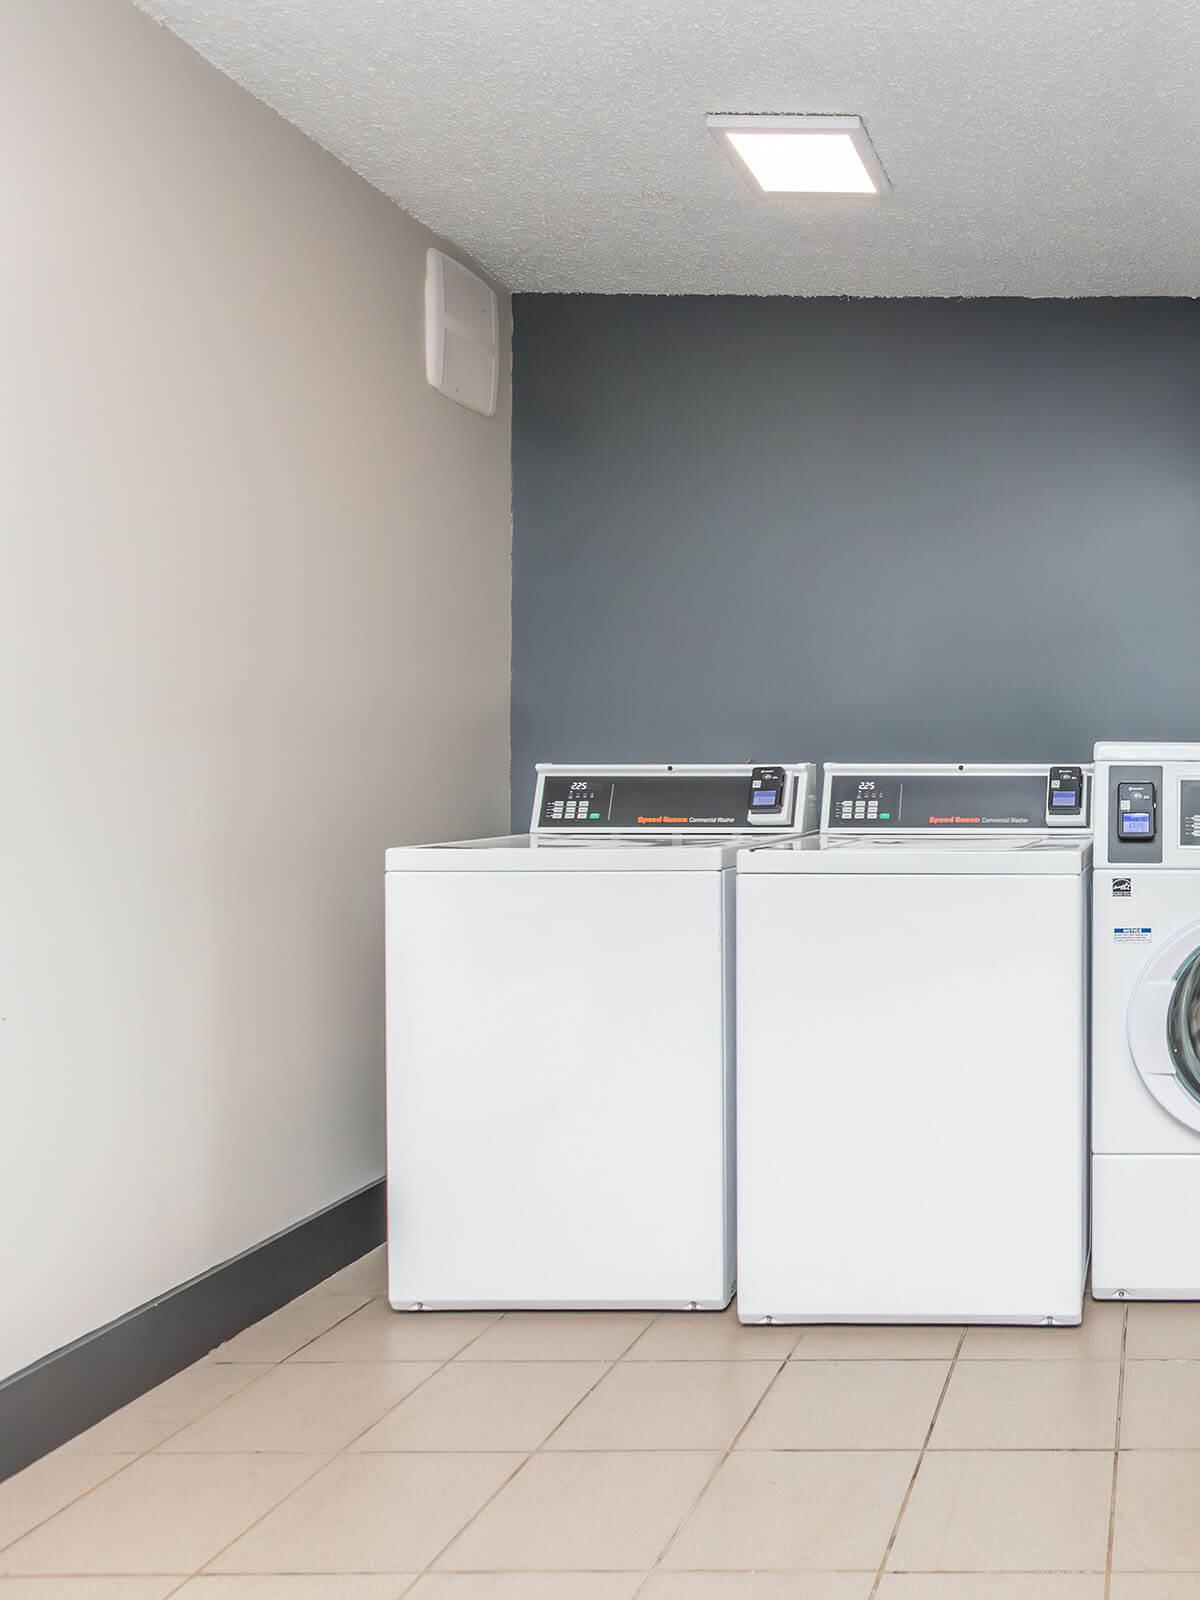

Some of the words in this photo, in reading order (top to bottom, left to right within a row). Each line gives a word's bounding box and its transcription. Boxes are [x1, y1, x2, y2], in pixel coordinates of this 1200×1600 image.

[571, 782, 587, 790] 225
[859, 782, 875, 790] 225
[637, 816, 662, 824] Speed
[928, 816, 954, 824] Speed
